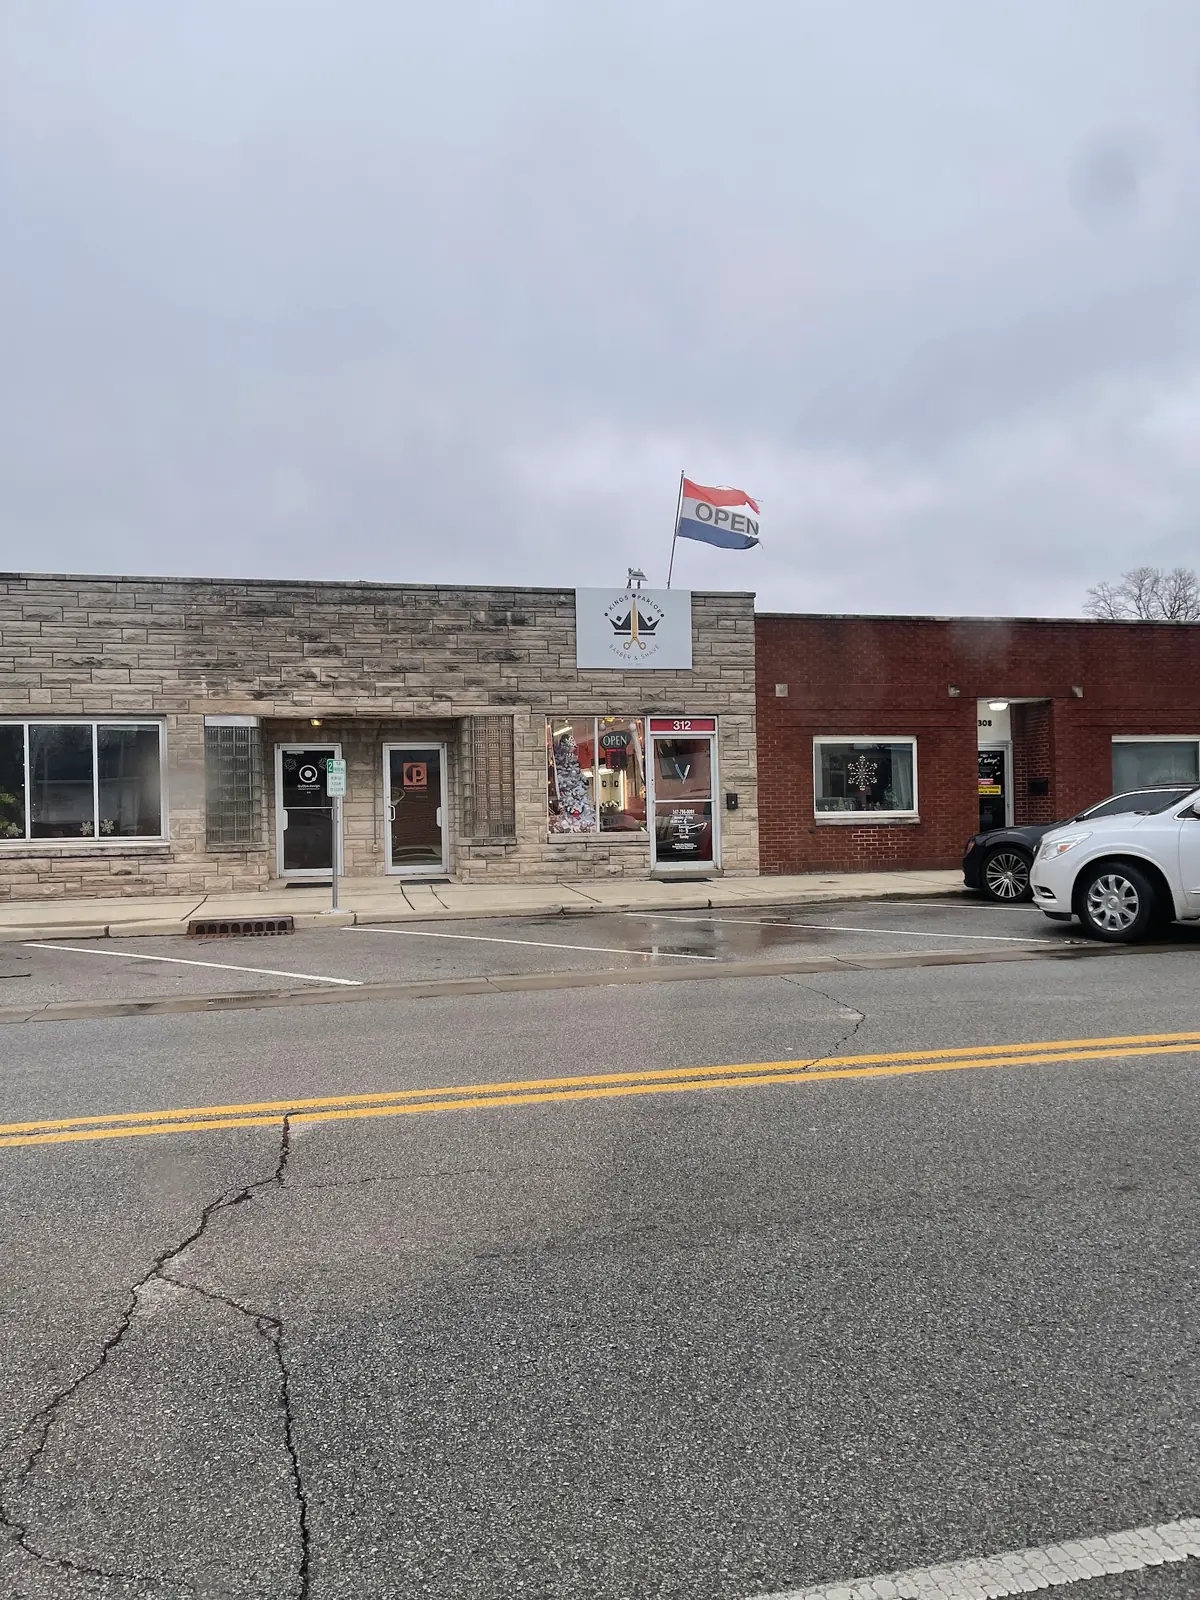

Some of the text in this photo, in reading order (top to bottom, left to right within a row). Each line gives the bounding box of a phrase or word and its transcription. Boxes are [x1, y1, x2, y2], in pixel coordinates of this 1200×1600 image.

[695, 502, 760, 536] OPEN
[608, 594, 662, 614] KINGS PARLOR
[608, 643, 632, 660] BARBER
[640, 644, 660, 659] SHAVE
[673, 720, 691, 731] 312
[978, 719, 992, 727] 308
[602, 735, 627, 747] OPEN
[328, 761, 333, 772] 2
